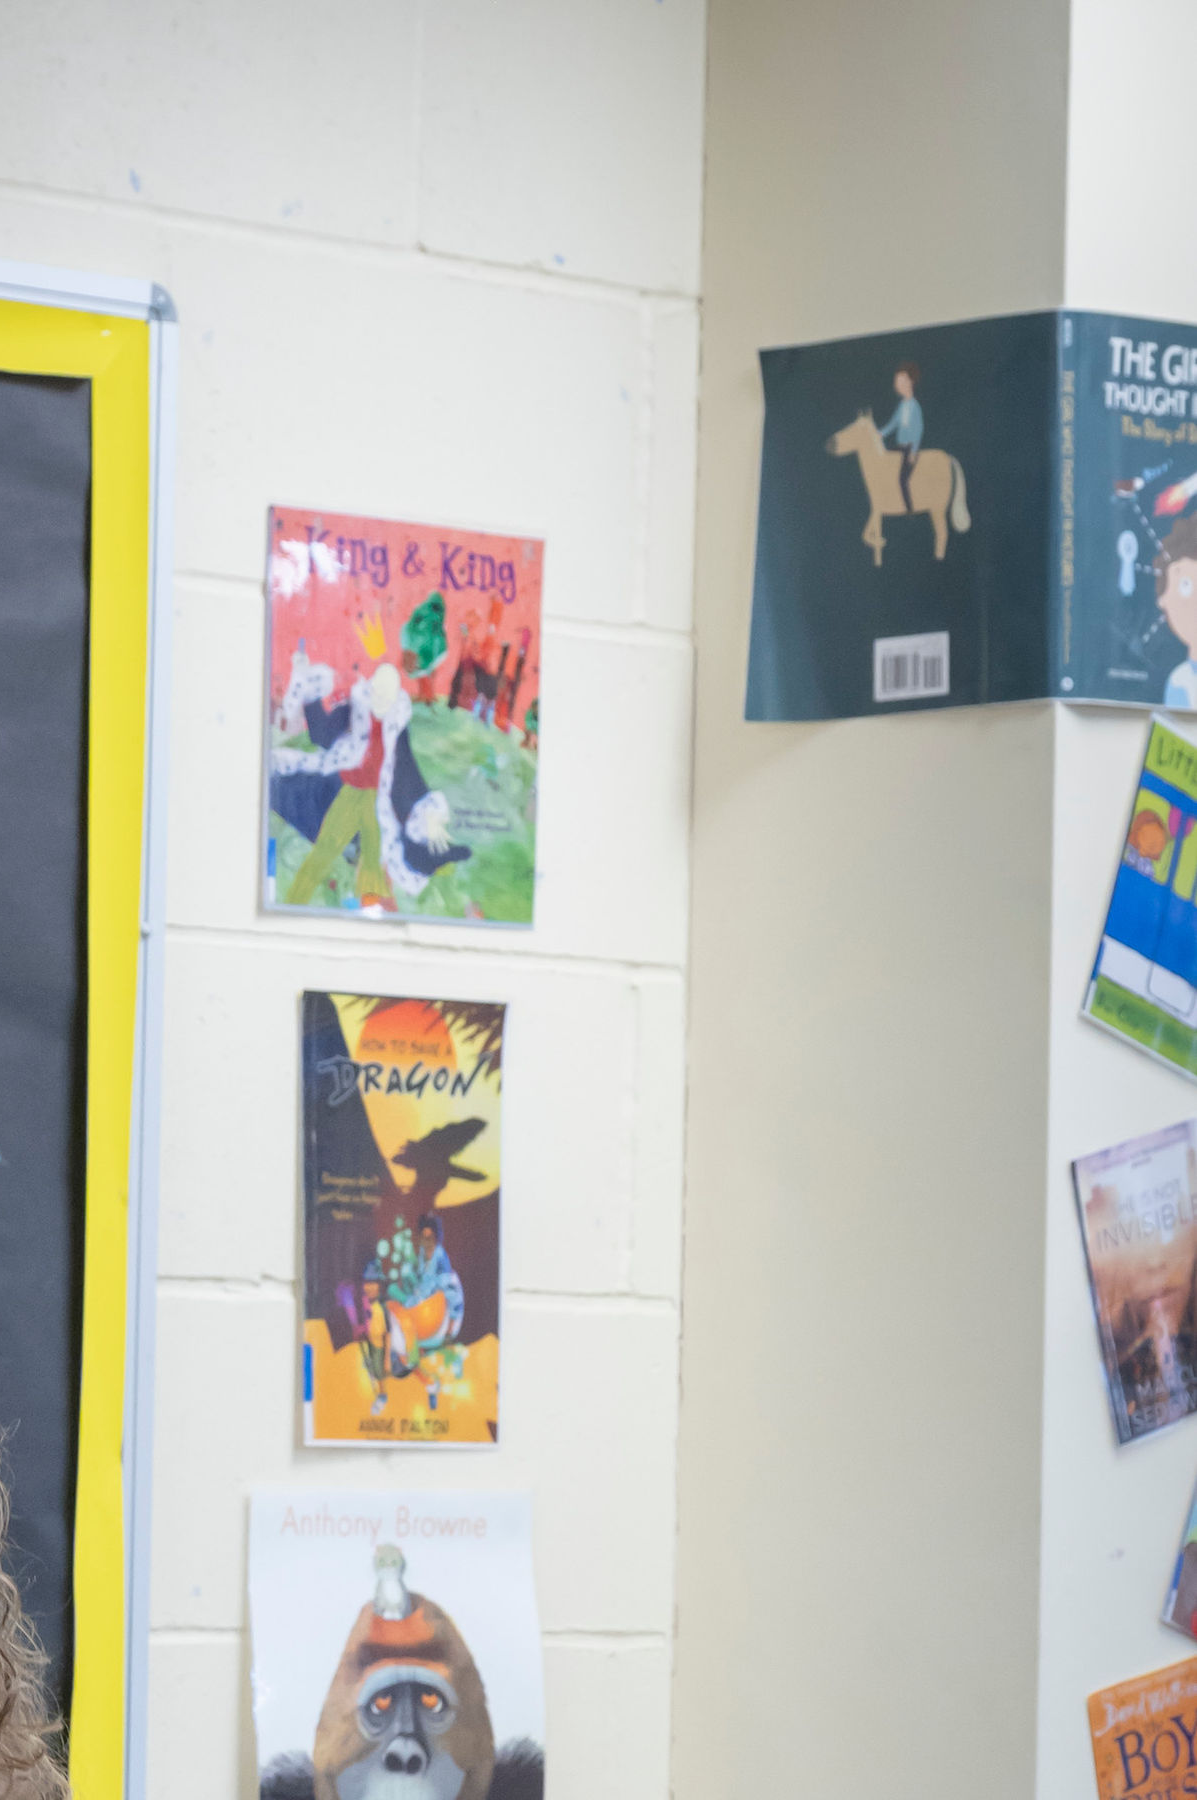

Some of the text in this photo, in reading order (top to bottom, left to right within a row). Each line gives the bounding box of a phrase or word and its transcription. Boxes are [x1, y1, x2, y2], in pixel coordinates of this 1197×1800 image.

[1108, 336, 1159, 381] THE
[1103, 381, 1190, 417] THOUGHT
[304, 525, 517, 604] King & King
[315, 1050, 495, 1107] DRAGON
[280, 1505, 488, 1545] Anthony Browne
